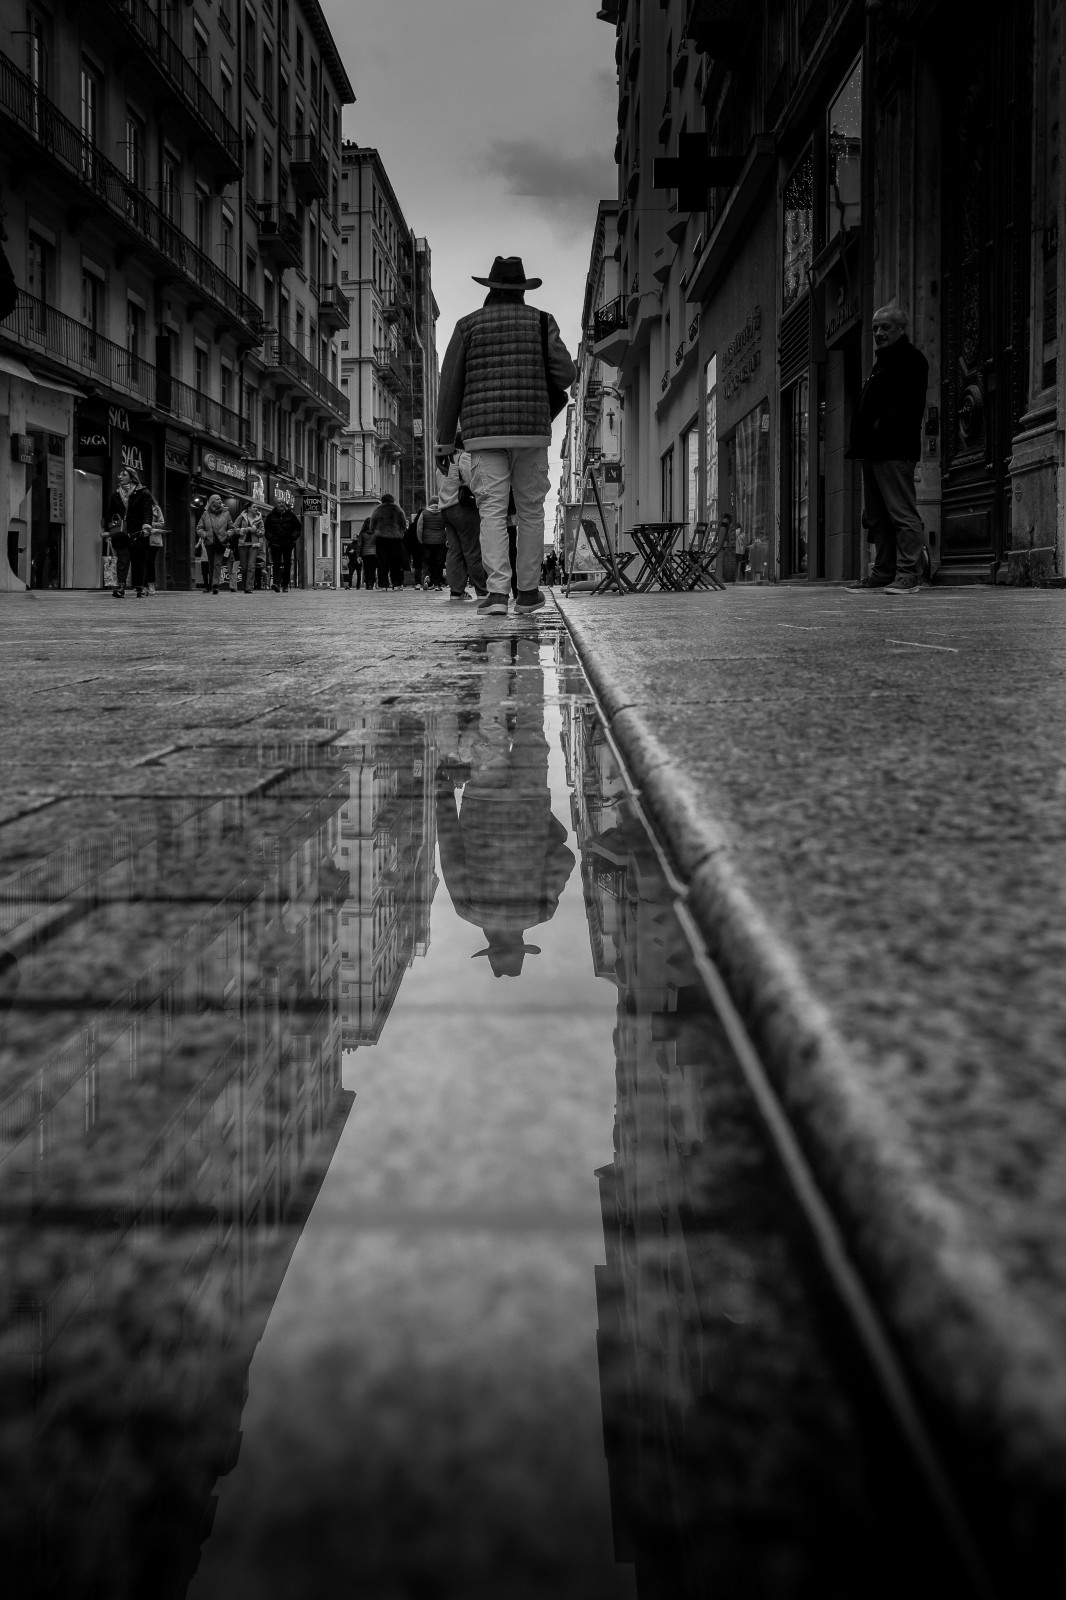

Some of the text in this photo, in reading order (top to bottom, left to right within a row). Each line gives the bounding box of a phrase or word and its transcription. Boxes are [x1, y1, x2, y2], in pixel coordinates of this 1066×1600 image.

[108, 405, 129, 432] SAGA
[80, 434, 107, 446] SAGA
[121, 444, 144, 471] SAGA
